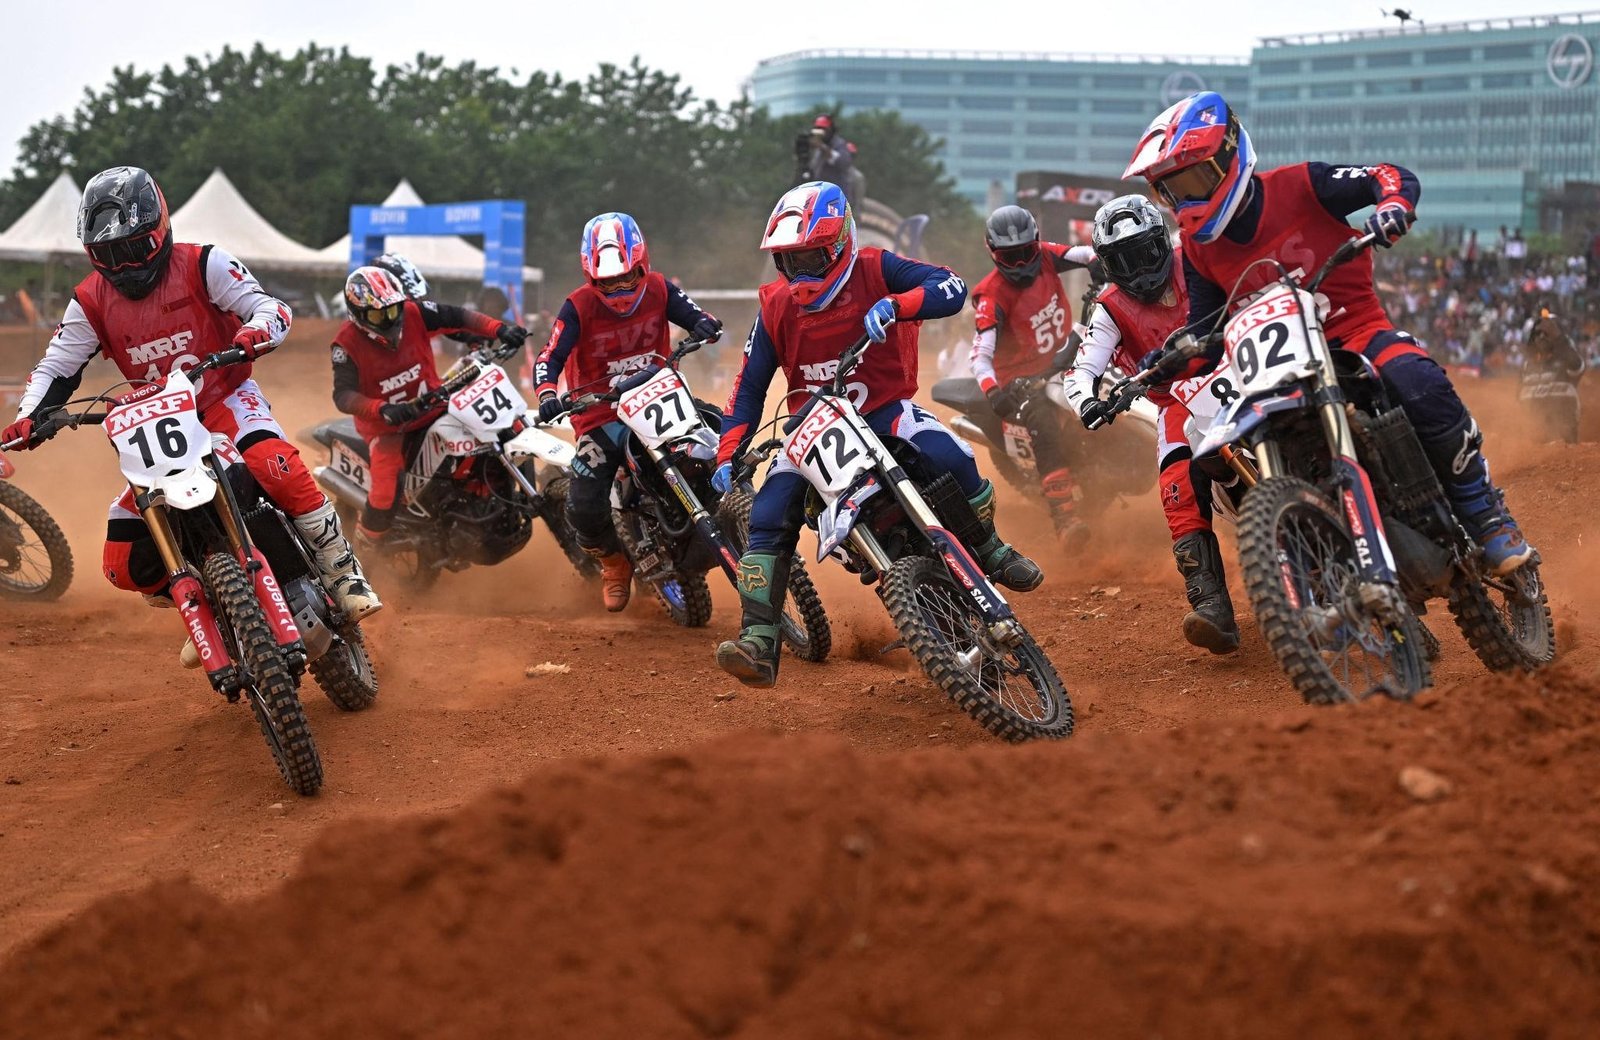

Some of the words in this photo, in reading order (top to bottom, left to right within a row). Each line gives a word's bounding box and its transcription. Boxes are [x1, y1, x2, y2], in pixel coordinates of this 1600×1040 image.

[1226, 297, 1296, 354] MRF
[125, 330, 193, 365] MRF
[1237, 322, 1296, 385] 92
[132, 385, 157, 399] Hero
[379, 363, 421, 394] MRF
[455, 371, 499, 407] MRF
[624, 376, 678, 414] MRF
[110, 394, 189, 435] MRF
[471, 387, 513, 425] 54
[644, 391, 687, 437] 27
[128, 417, 188, 469] 16
[788, 401, 839, 467] MRF
[340, 453, 365, 485] 54
[804, 427, 860, 486] 72
[944, 555, 975, 587] Racing
[1355, 538, 1373, 568] TVS
[262, 575, 288, 613] Hero
[970, 588, 992, 612] TVS
[189, 618, 212, 660] Hero
